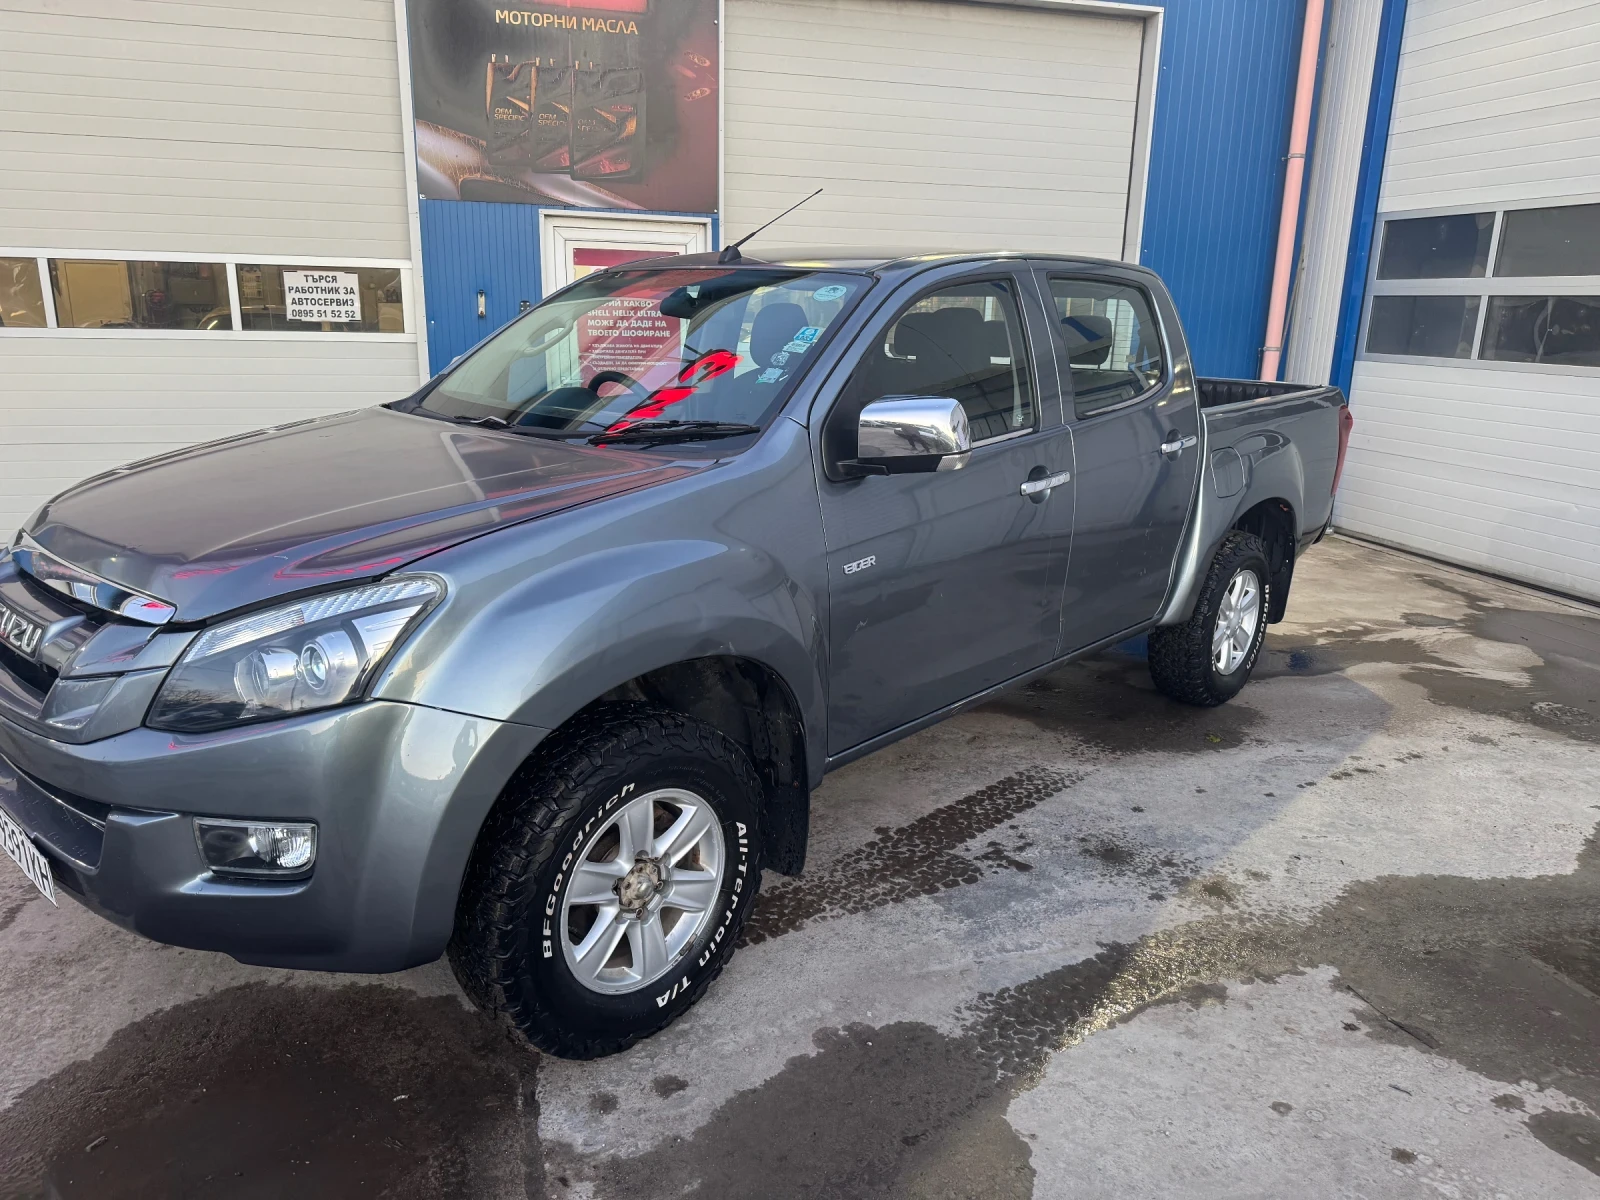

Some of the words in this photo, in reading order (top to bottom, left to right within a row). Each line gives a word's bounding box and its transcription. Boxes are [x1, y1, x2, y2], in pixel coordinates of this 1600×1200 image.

[495, 9, 577, 30] МОТОРНИ
[582, 17, 638, 35] МАСЛА
[303, 274, 338, 284] ТЪРСЯ
[288, 286, 341, 295] РАБОТНИК
[343, 286, 356, 295] ЗА
[290, 297, 355, 307] АВТОСЕРВИЗ
[623, 300, 653, 308] КАКВО
[291, 309, 314, 318] 0895
[317, 309, 328, 318] 51
[330, 309, 342, 318] 52
[344, 310, 356, 319] 52
[612, 309, 635, 317] HELIX
[637, 310, 662, 318] ULTRA
[587, 319, 614, 327] МОЖЕ
[616, 319, 628, 327] ДА
[630, 320, 653, 328] ДАДЕ
[587, 329, 620, 337] ТВОЕТО
[621, 329, 671, 338] ШОФИРАНЕ
[542, 782, 636, 958] BFGoodrich
[698, 820, 748, 967] All-Terrain
[655, 975, 692, 1008] T/A
